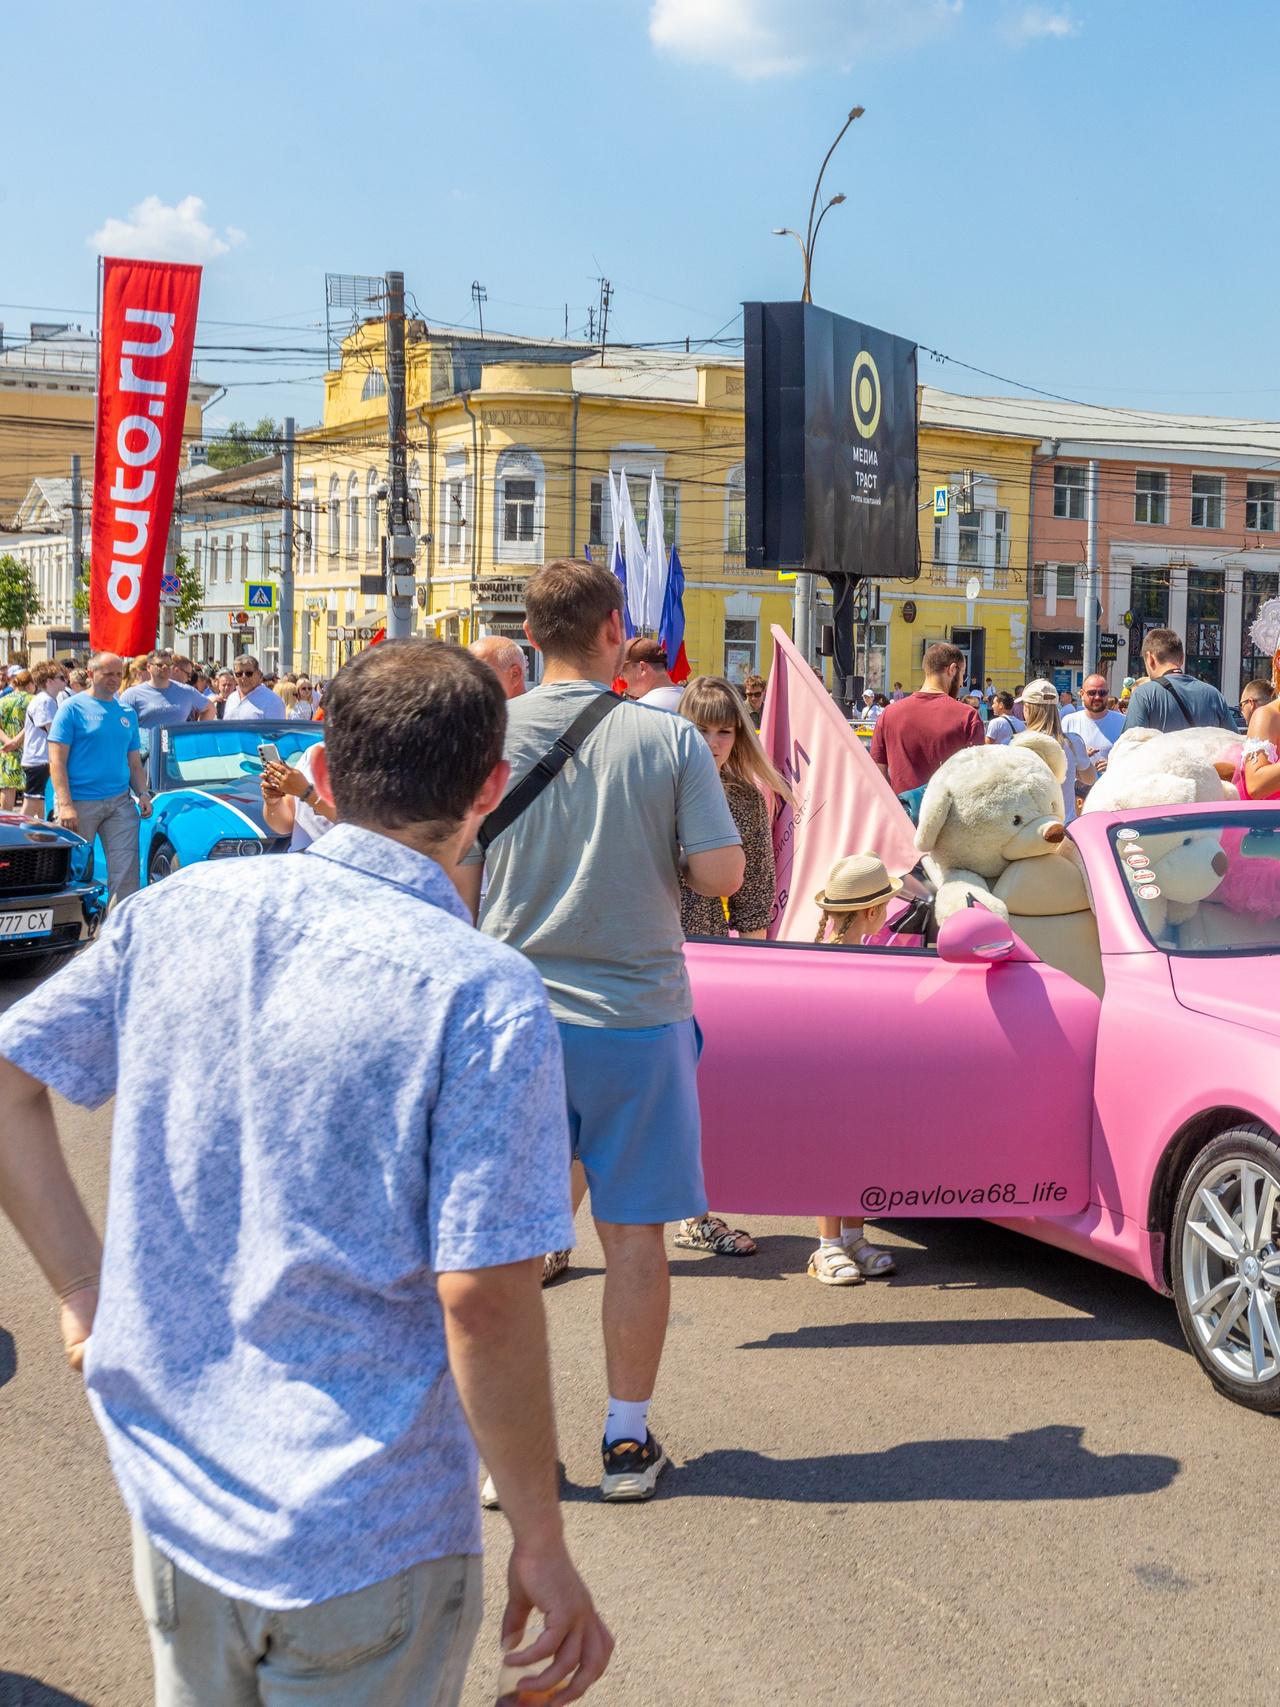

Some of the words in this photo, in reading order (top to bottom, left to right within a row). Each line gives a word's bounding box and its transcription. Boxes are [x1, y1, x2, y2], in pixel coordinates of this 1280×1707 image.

[107, 308, 175, 613] auto.ru
[852, 446, 878, 466] МЕДИА
[855, 470, 878, 489] ТРАСТ
[478, 582, 525, 593] КОНДИТЕ
[860, 1182, 1068, 1212] @pavlova68_life
